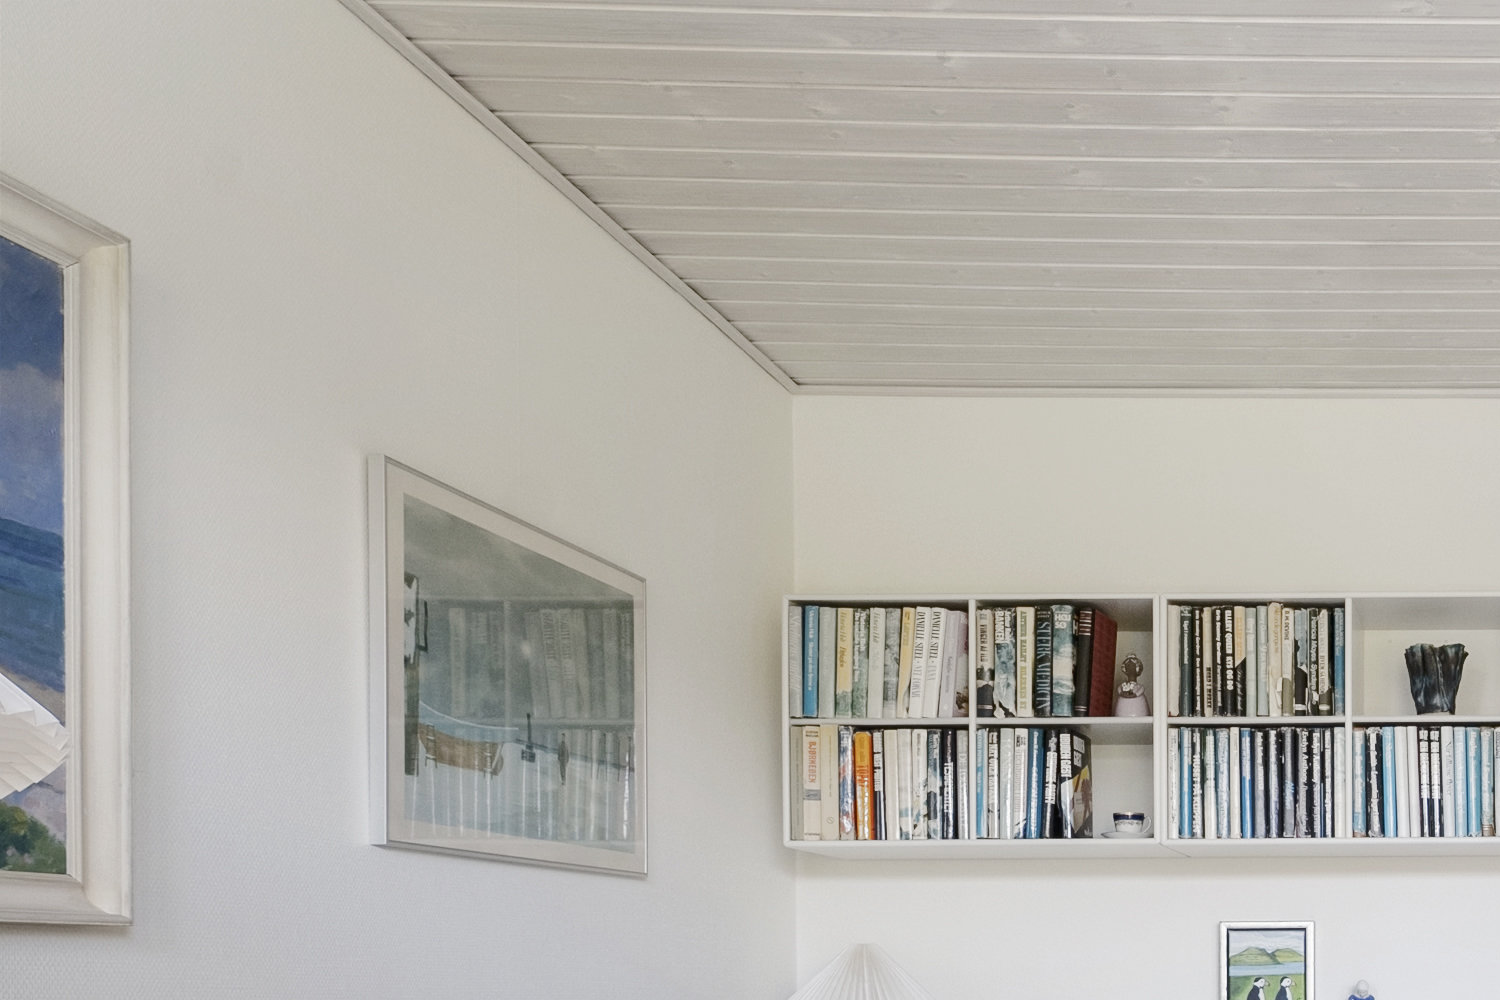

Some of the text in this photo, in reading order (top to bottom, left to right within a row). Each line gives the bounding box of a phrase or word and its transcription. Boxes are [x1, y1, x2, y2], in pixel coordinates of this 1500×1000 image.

[915, 611, 926, 640] DANIELLE
[1225, 610, 1233, 632] ELLERY
[929, 611, 942, 660] DANIELLE STEEL
[1225, 633, 1233, 654] QUEEN
[914, 642, 923, 660] STEEL
[1037, 662, 1050, 709] MEDICIN
[1312, 733, 1320, 754] Evelyn
[1193, 755, 1201, 783] HUSET
[1312, 754, 1320, 784] Anthony
